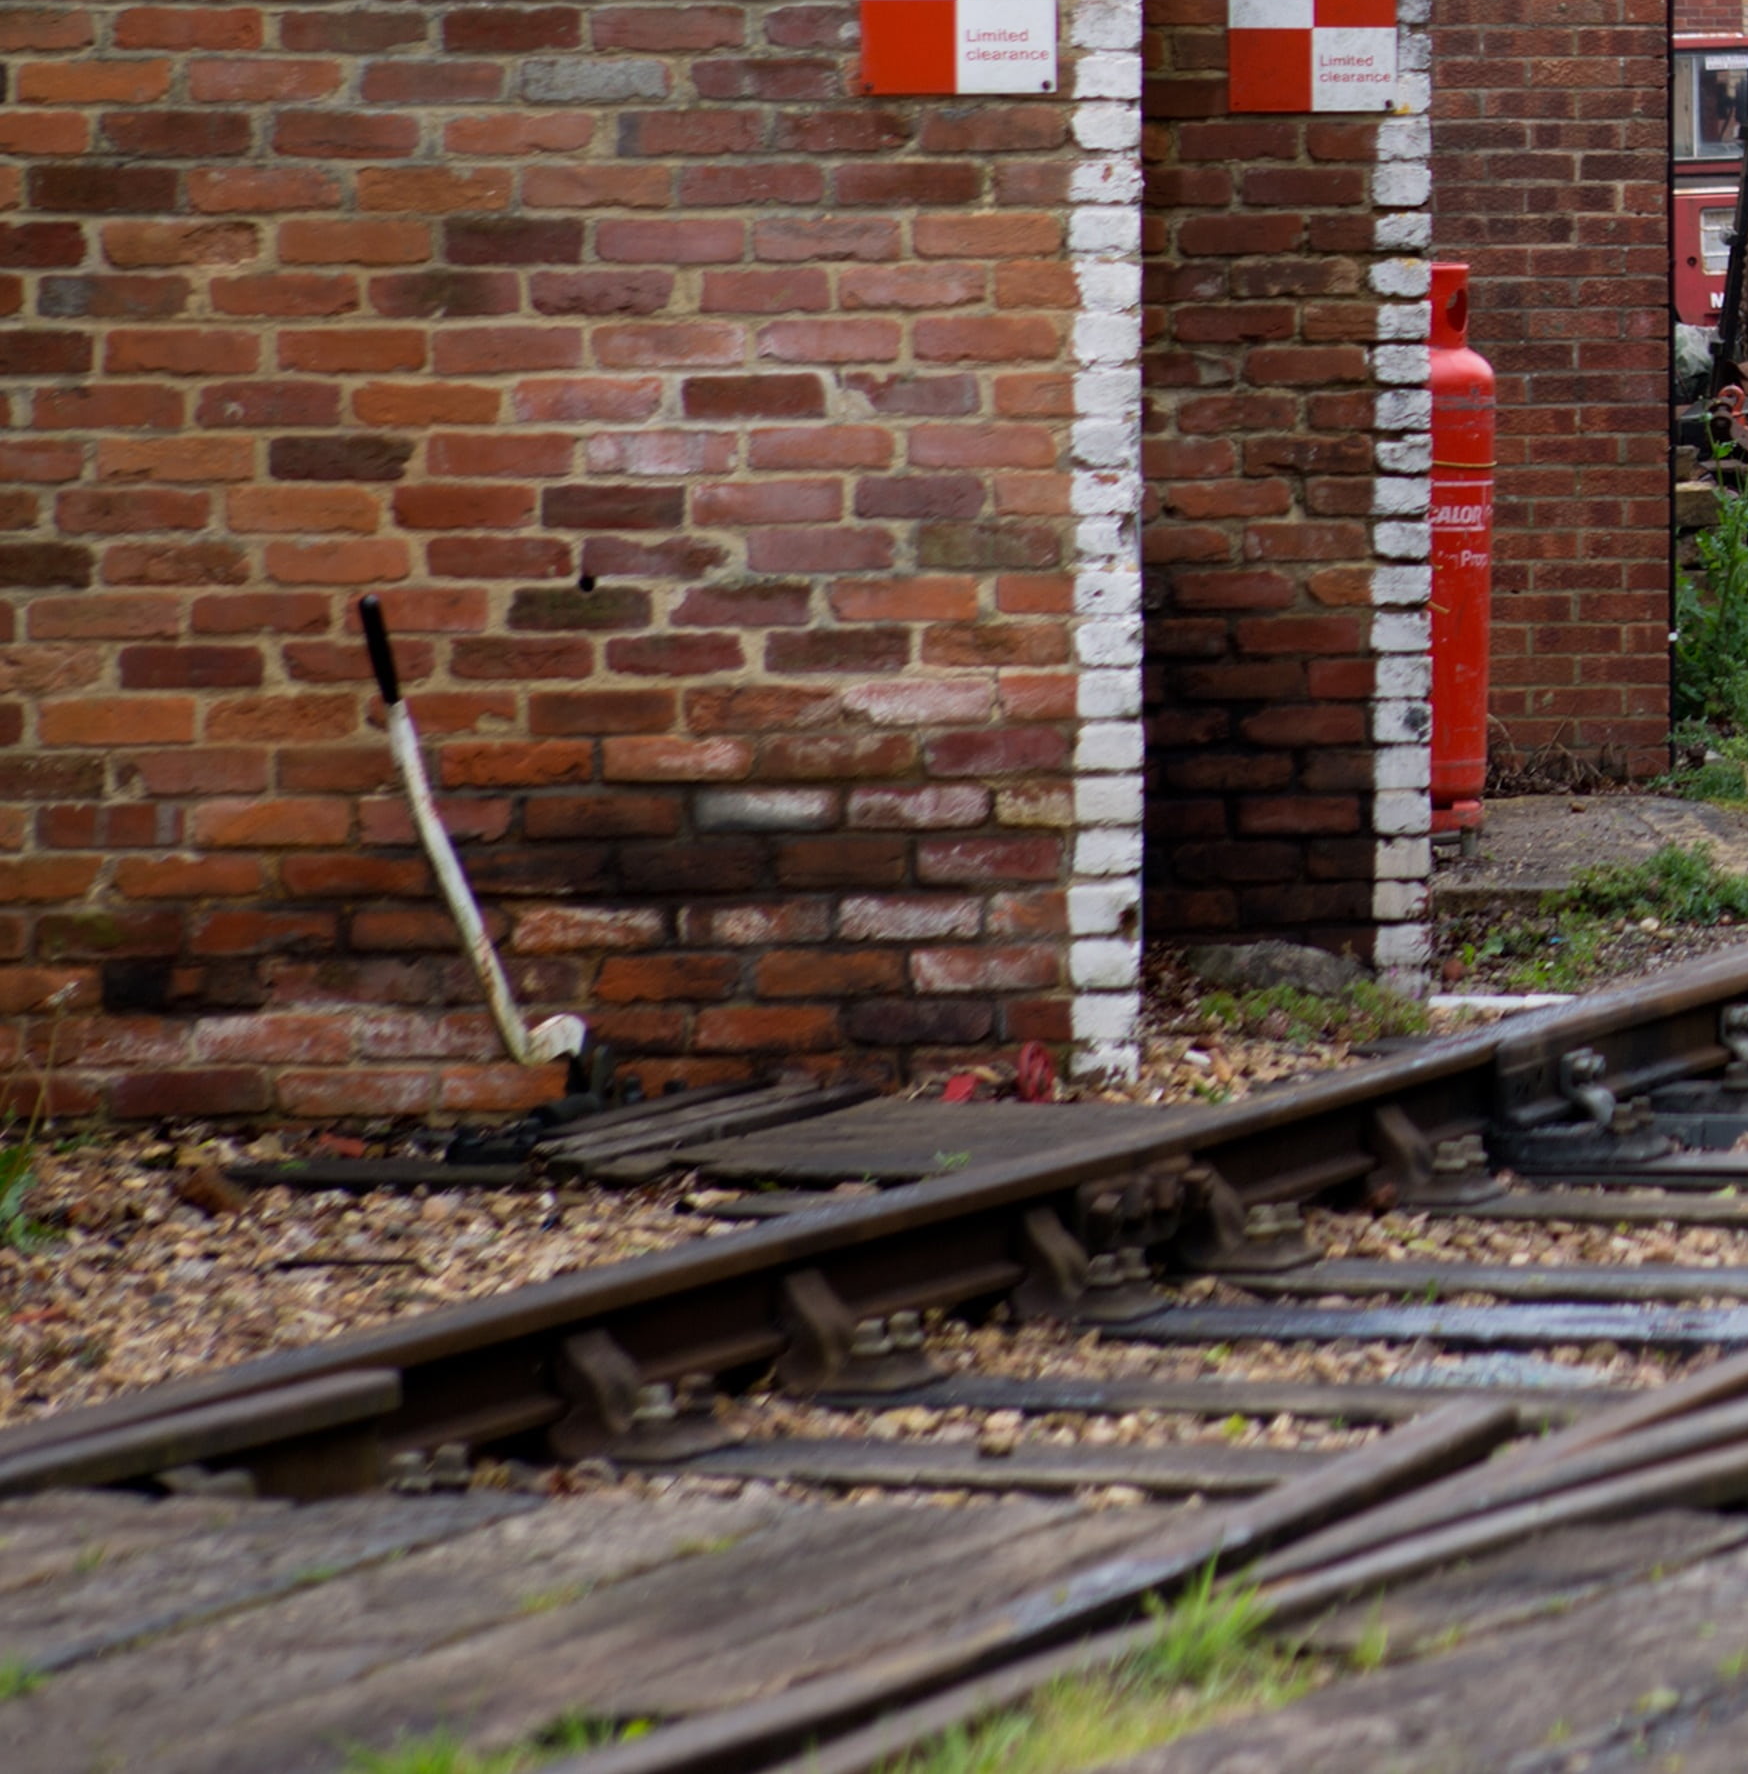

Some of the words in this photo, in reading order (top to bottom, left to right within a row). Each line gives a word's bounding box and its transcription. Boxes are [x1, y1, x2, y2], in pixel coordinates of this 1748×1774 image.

[966, 29, 1029, 42] Limited
[966, 48, 1050, 61] clearance
[1320, 54, 1374, 67] Limited
[1320, 71, 1391, 83] clearance
